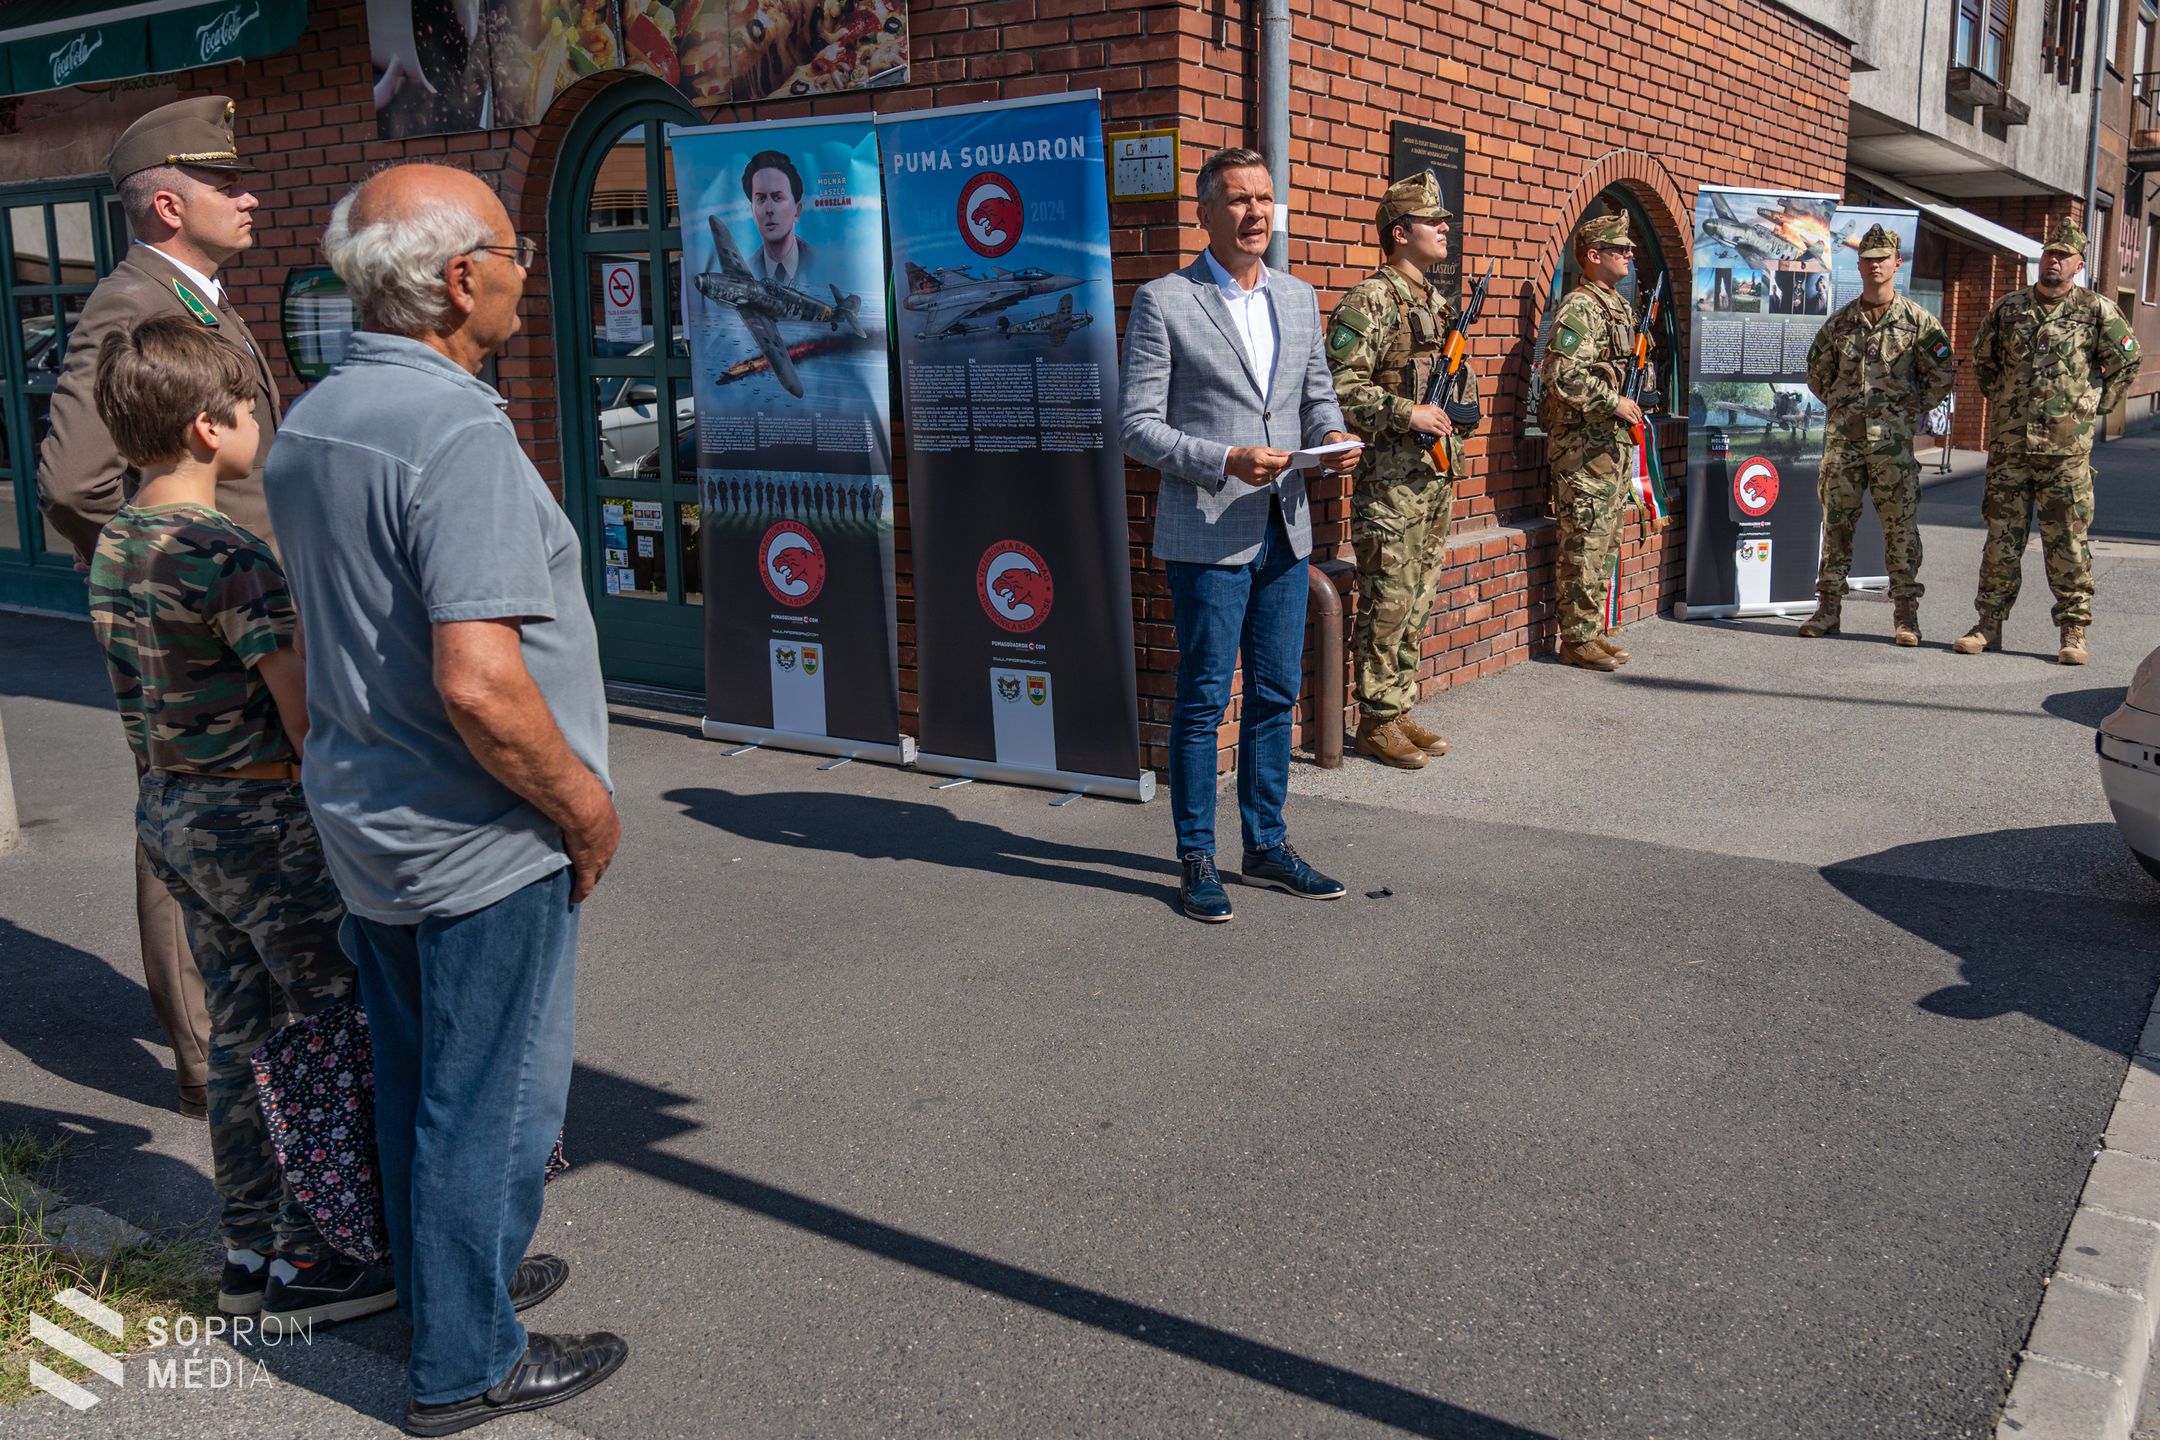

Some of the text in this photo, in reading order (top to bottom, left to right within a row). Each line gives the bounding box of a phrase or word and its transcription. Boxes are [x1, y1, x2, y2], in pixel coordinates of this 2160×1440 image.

[894, 136, 1085, 175] PUMA SQUADRON
[1031, 200, 1066, 222] 2024
